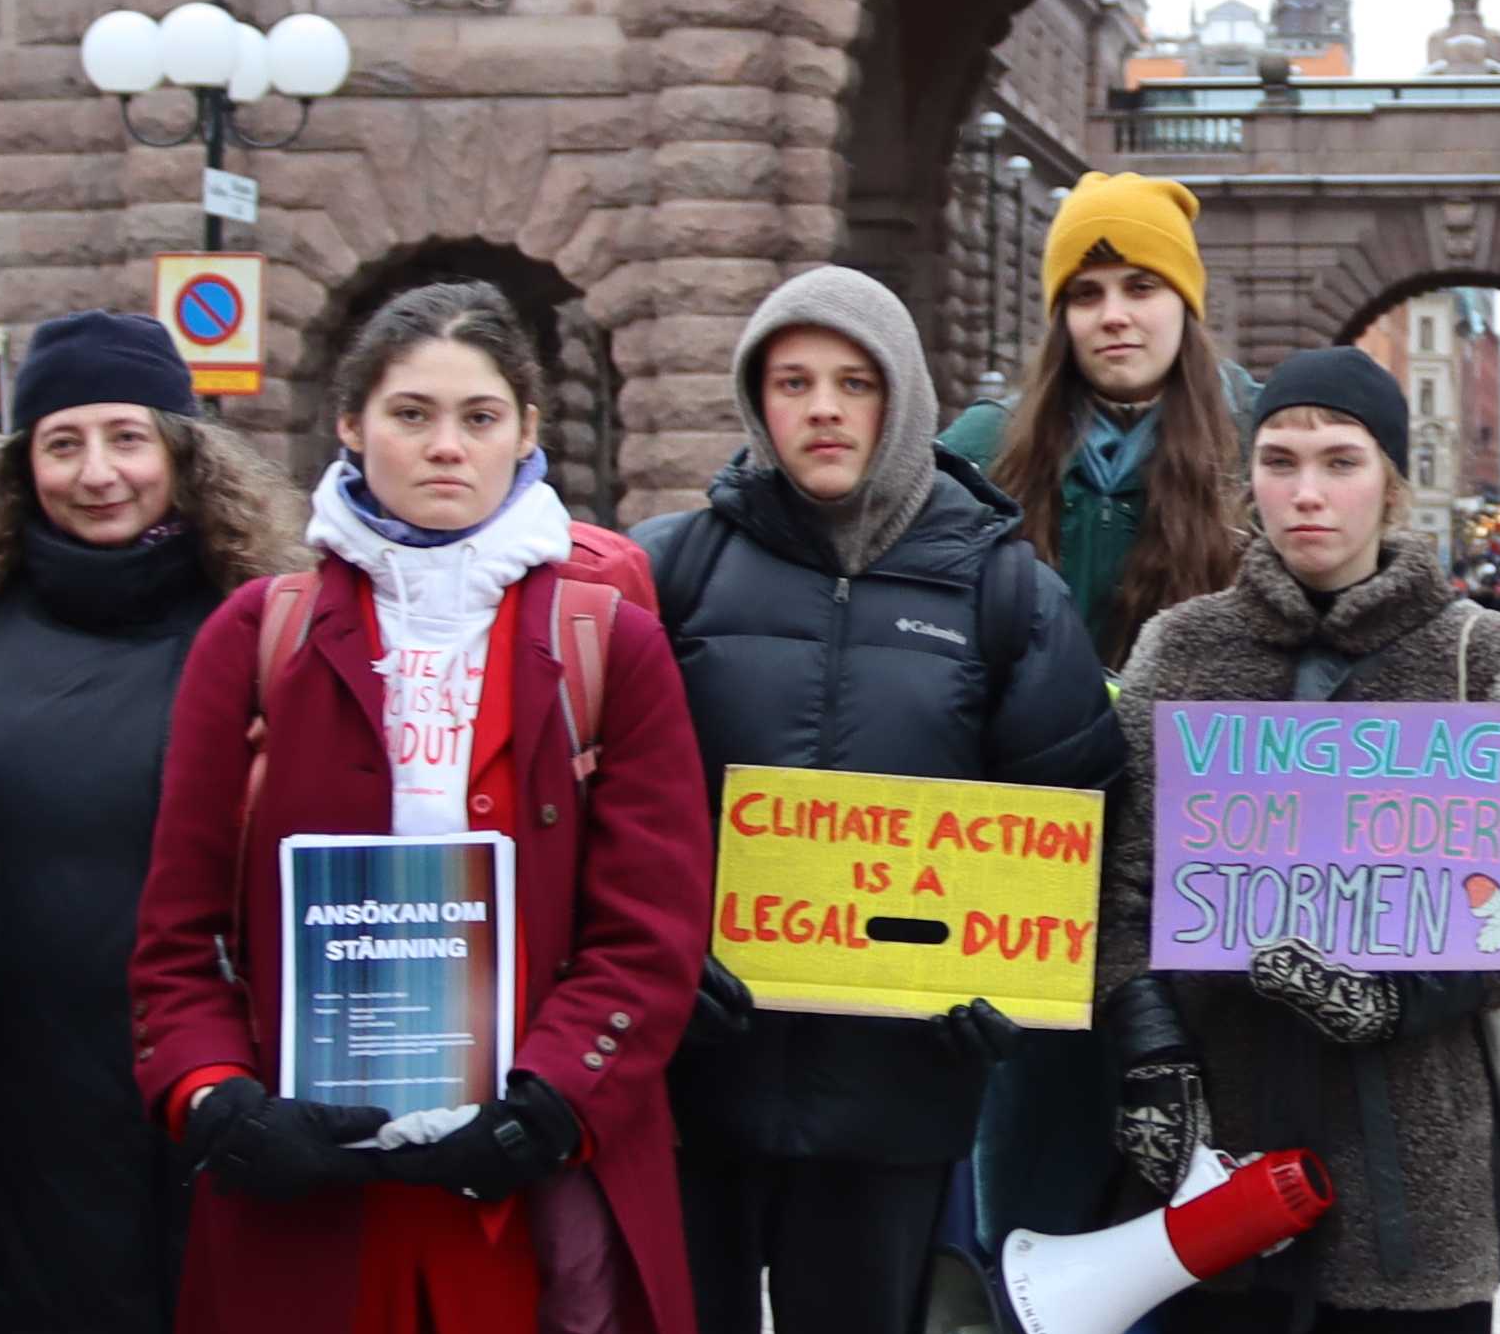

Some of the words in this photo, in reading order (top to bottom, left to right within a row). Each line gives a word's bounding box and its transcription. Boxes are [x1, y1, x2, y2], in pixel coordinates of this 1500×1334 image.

[397, 721, 471, 766] DUT
[729, 792, 911, 848] CLIMATE
[926, 811, 1093, 866] ACTION
[1182, 789, 1302, 855] SOM
[851, 861, 892, 894] IS
[911, 865, 946, 897] A
[304, 899, 439, 925] ANSÖKAN
[441, 901, 487, 923] OM
[719, 891, 870, 950] LEGAL
[961, 910, 1093, 964] DUTY
[1171, 862, 1451, 957] STORMEN
[325, 935, 468, 961] STÄMNING
